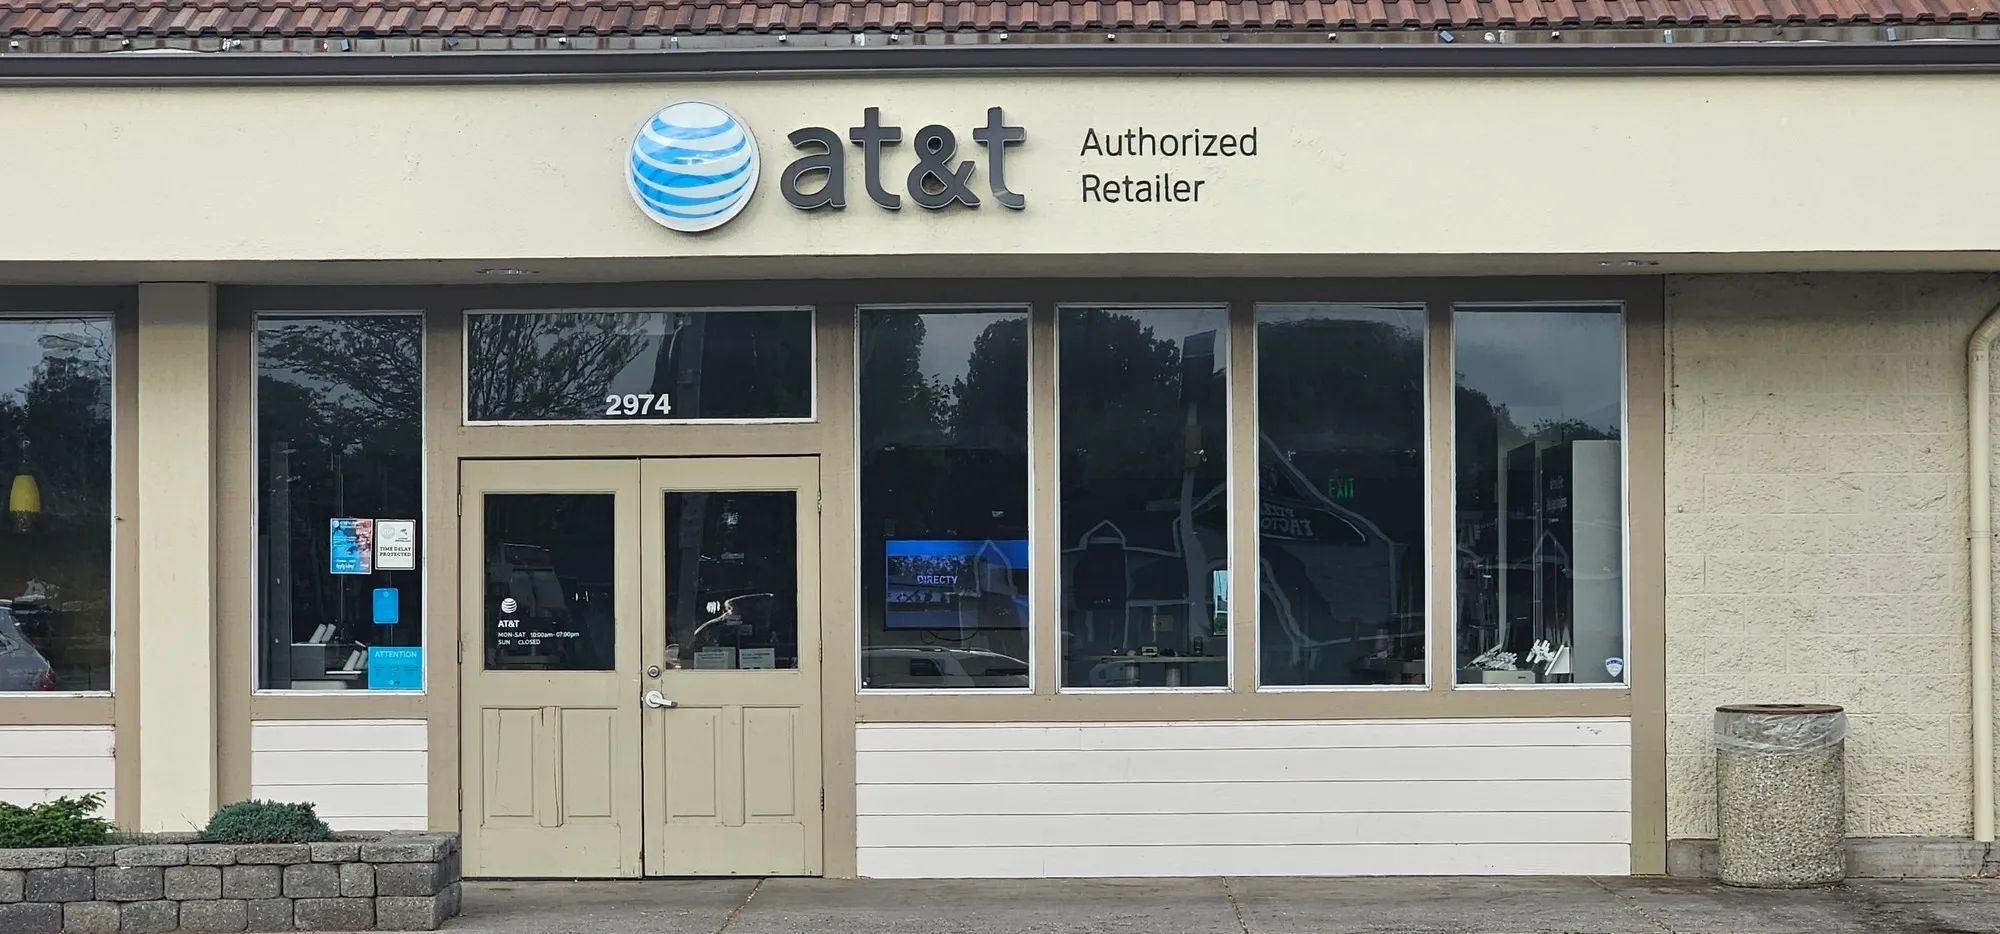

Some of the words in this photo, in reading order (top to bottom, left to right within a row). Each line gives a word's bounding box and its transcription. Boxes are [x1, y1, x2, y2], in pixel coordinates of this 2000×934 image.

[1080, 126, 1258, 157] Authorized
[780, 106, 1026, 210] at&t
[1081, 173, 1205, 203] Retailer
[605, 393, 671, 416] 2974
[1328, 477, 1355, 499] EXIT
[917, 575, 958, 584] DIRECTV
[497, 620, 520, 628] AT&T
[374, 650, 417, 658] ATTENTION
